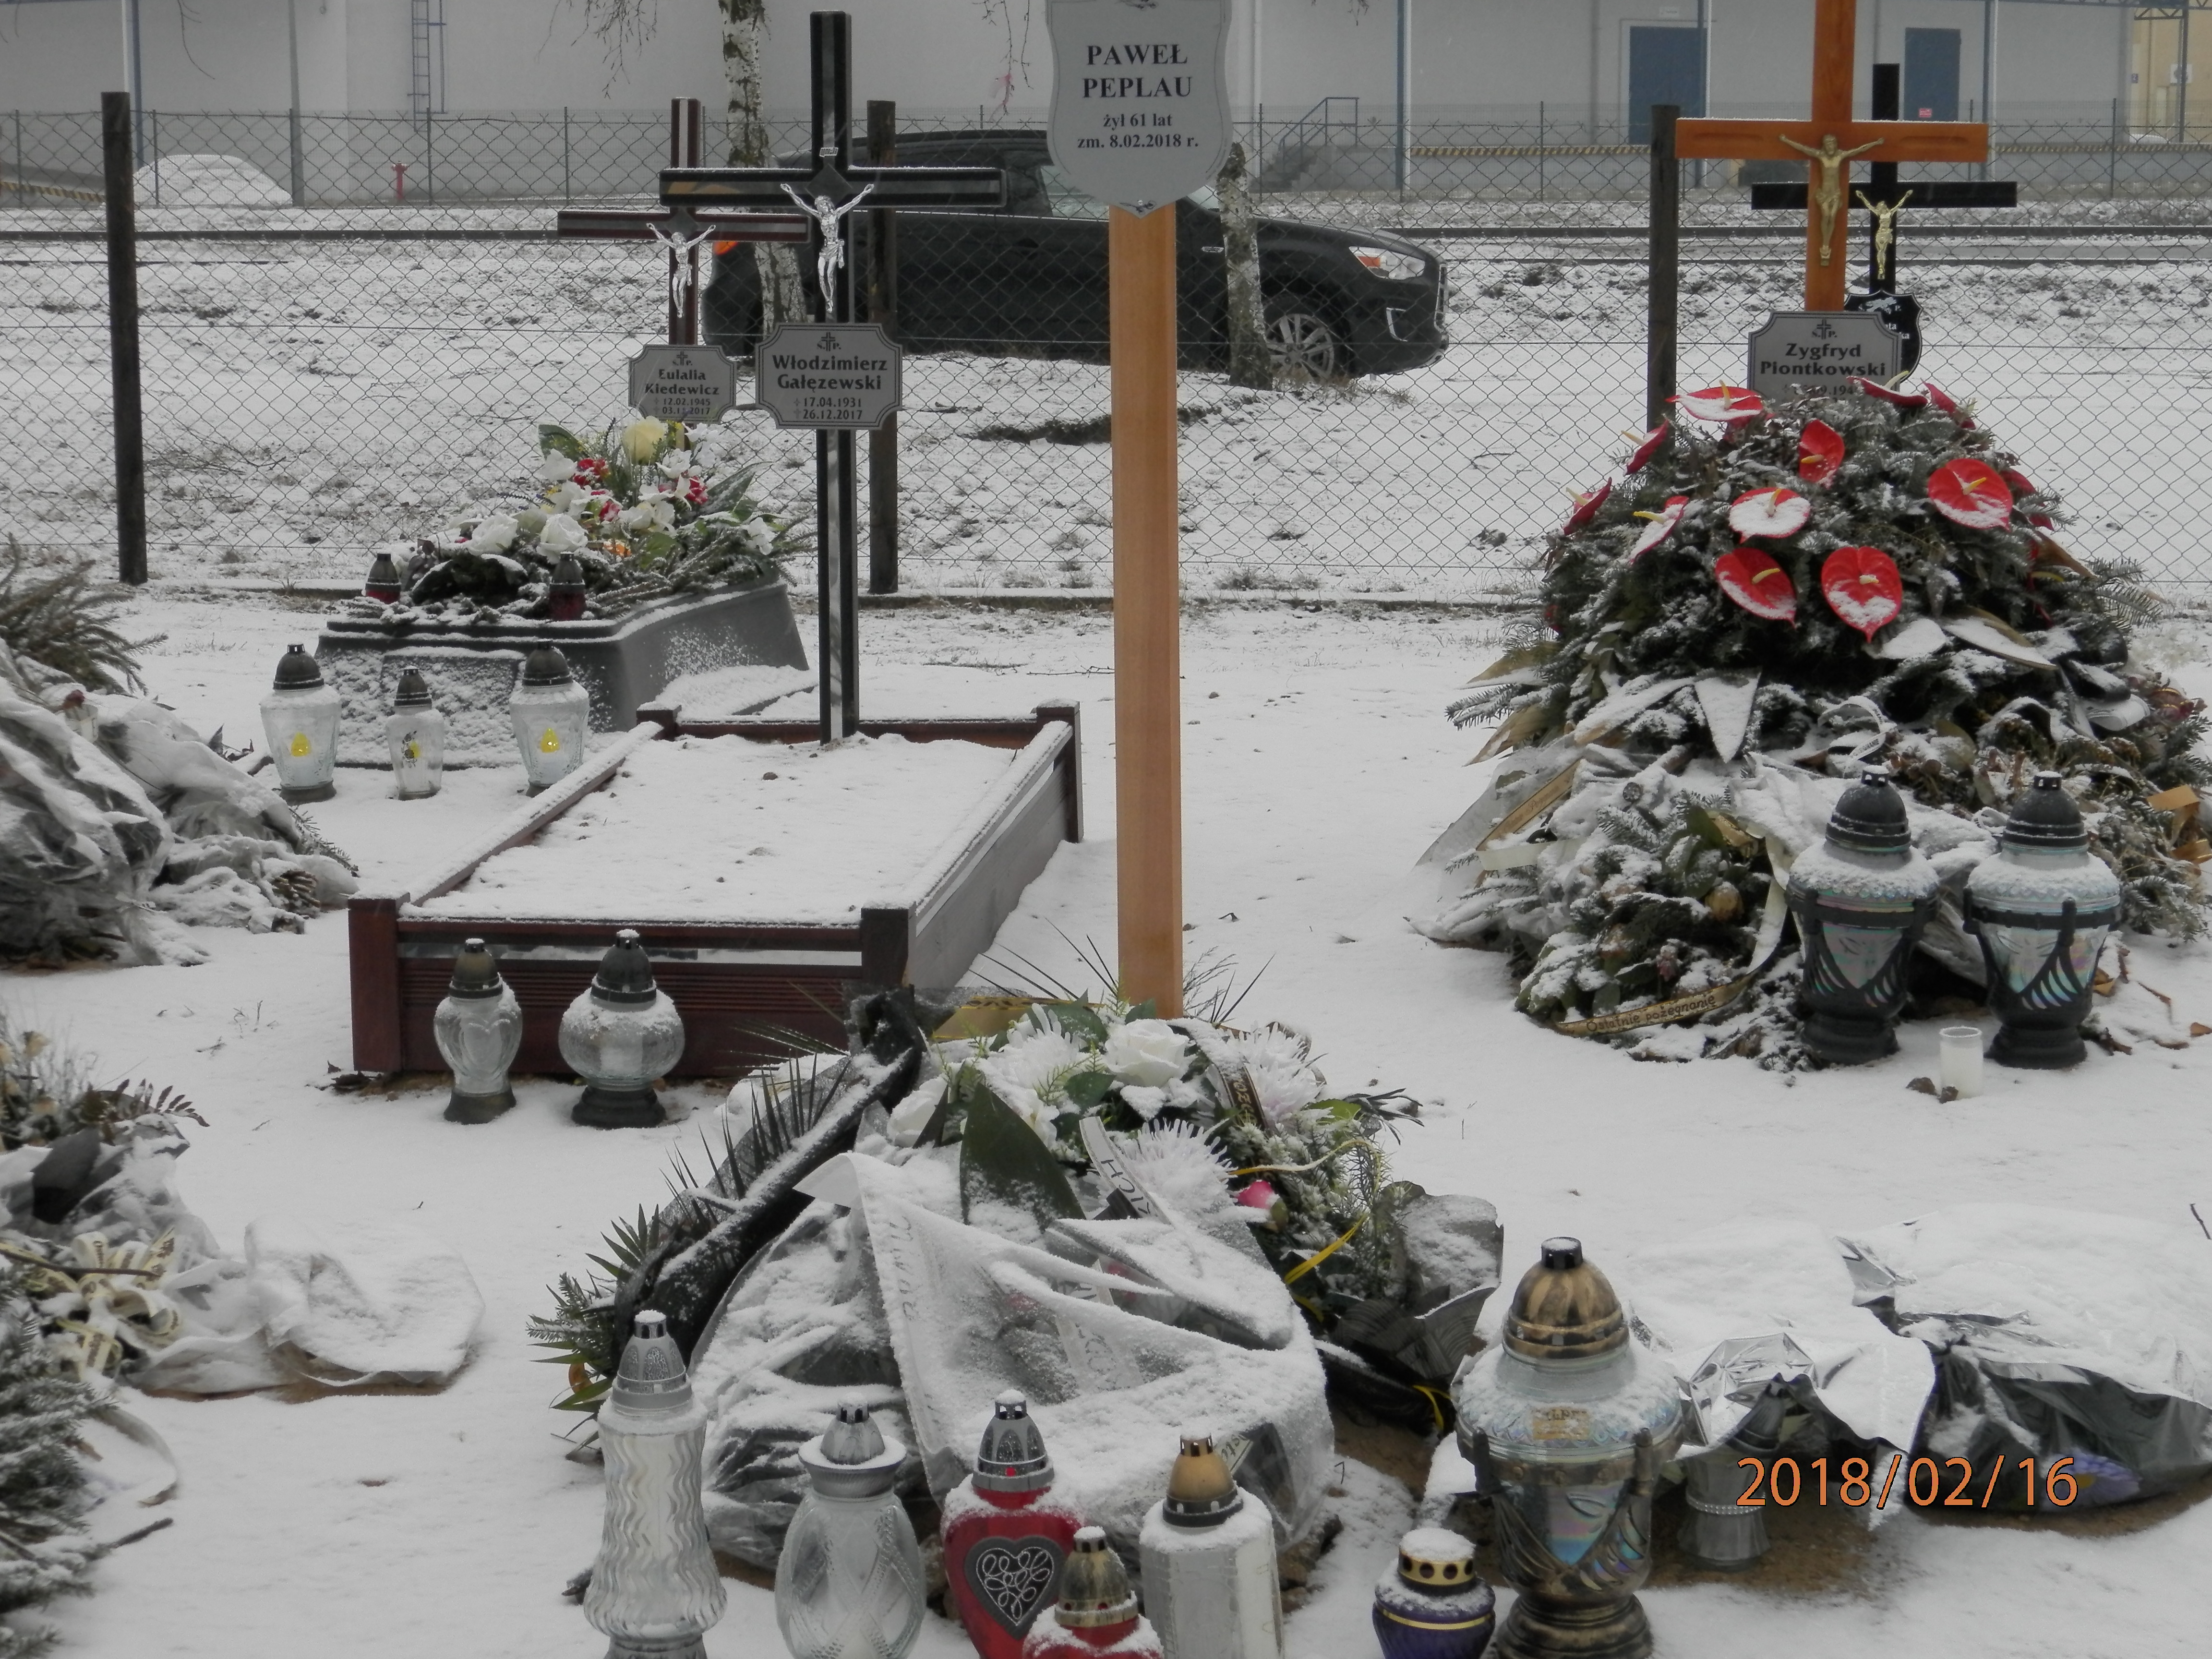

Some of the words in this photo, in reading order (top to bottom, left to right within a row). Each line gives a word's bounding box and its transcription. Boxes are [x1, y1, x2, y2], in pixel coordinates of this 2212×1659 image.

[1086, 44, 1188, 65] PAWEŁ
[1082, 77, 1192, 98] PEPLAU
[1104, 113, 1125, 131] żył
[1130, 114, 1146, 127] 61
[1153, 114, 1172, 127] lat
[1078, 137, 1105, 148] zm.
[1109, 134, 1182, 148] 8.02.2018
[1186, 137, 1199, 147] r.
[1785, 343, 1861, 360] Zygfryd
[772, 355, 888, 371] Włodzimierz
[1760, 361, 1886, 376] Piontkowski
[659, 369, 706, 380] Eulalia
[645, 384, 720, 395] Kiedewicz
[777, 374, 881, 392] Gałęzewski
[804, 397, 862, 407] 17.04.1931
[803, 409, 863, 420] 26.12.2017
[1586, 1013, 1640, 1032] Ostatnie
